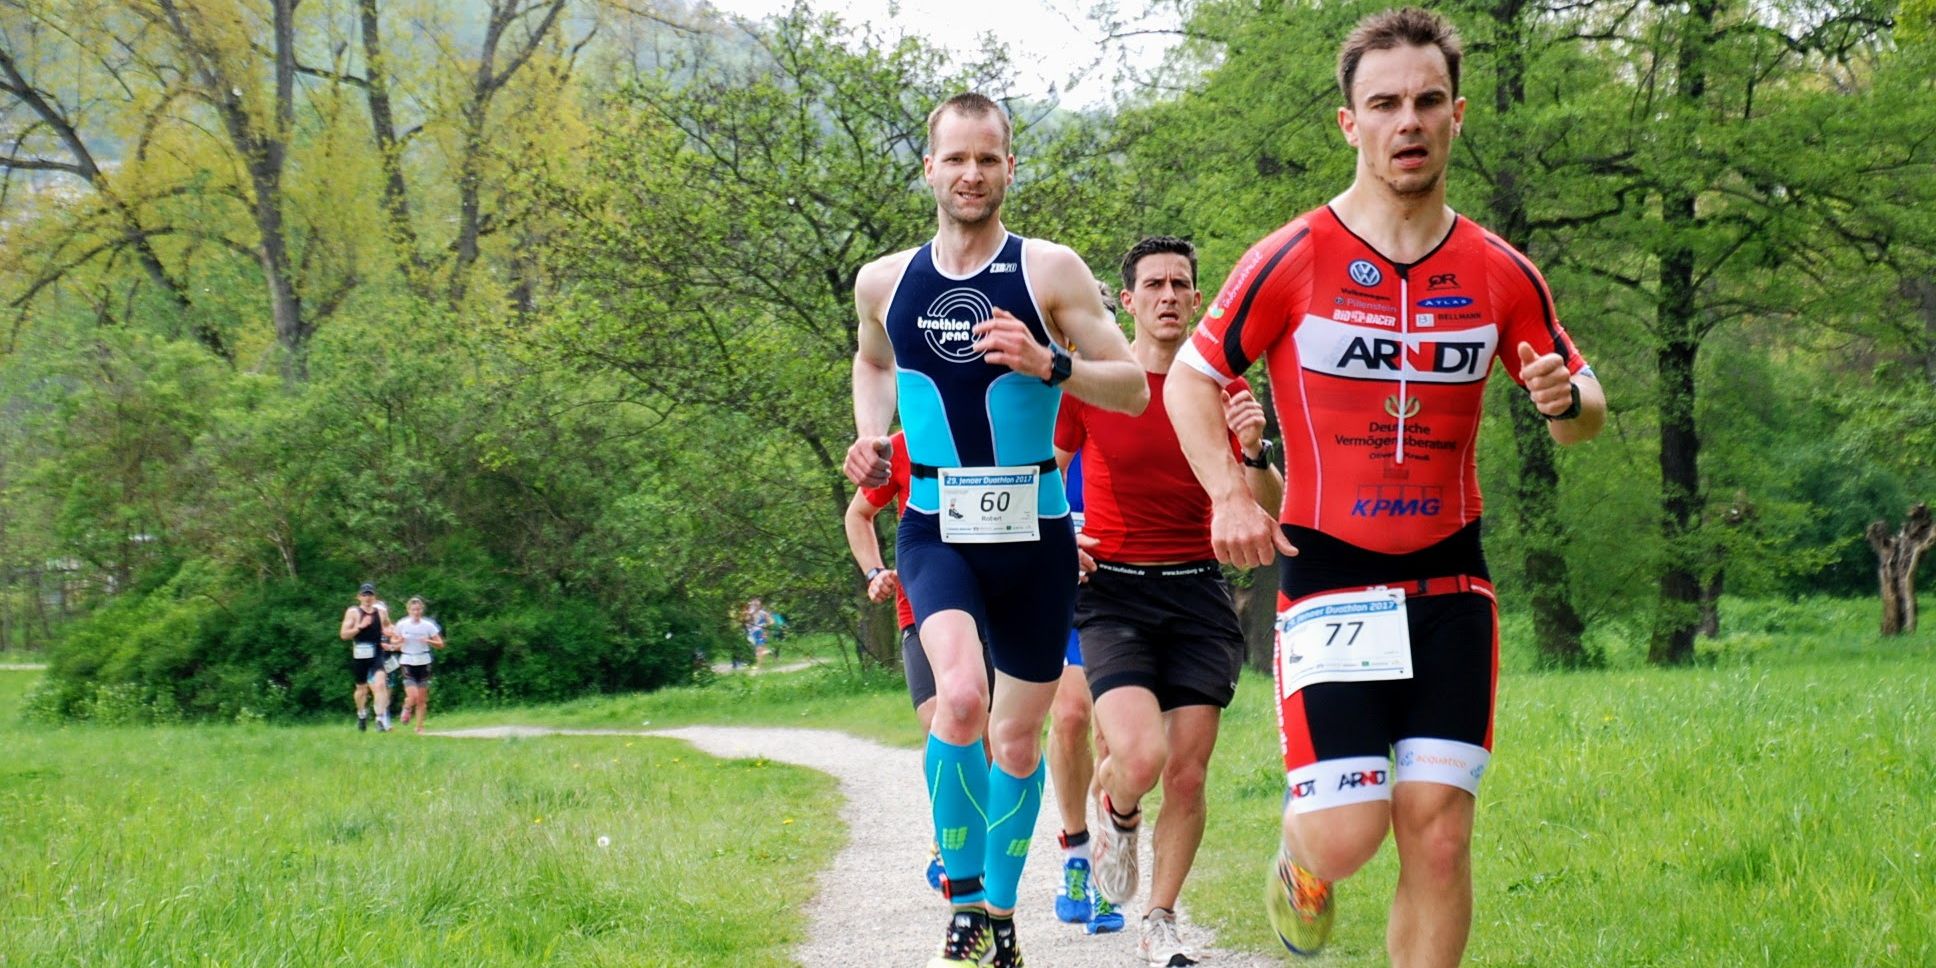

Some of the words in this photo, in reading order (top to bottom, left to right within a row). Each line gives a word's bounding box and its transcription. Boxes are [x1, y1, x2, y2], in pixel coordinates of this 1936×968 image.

[917, 316, 970, 330] triathlon
[939, 331, 970, 344] jena
[1336, 336, 1485, 374] ARNDT
[983, 475, 1014, 484] Duathlon
[1015, 474, 1033, 483] 2017
[980, 491, 1011, 512] 60
[1352, 498, 1441, 517] KPMG
[1325, 603, 1368, 616] Duathlon
[1369, 600, 1396, 611] 2017
[1325, 621, 1364, 646] 77
